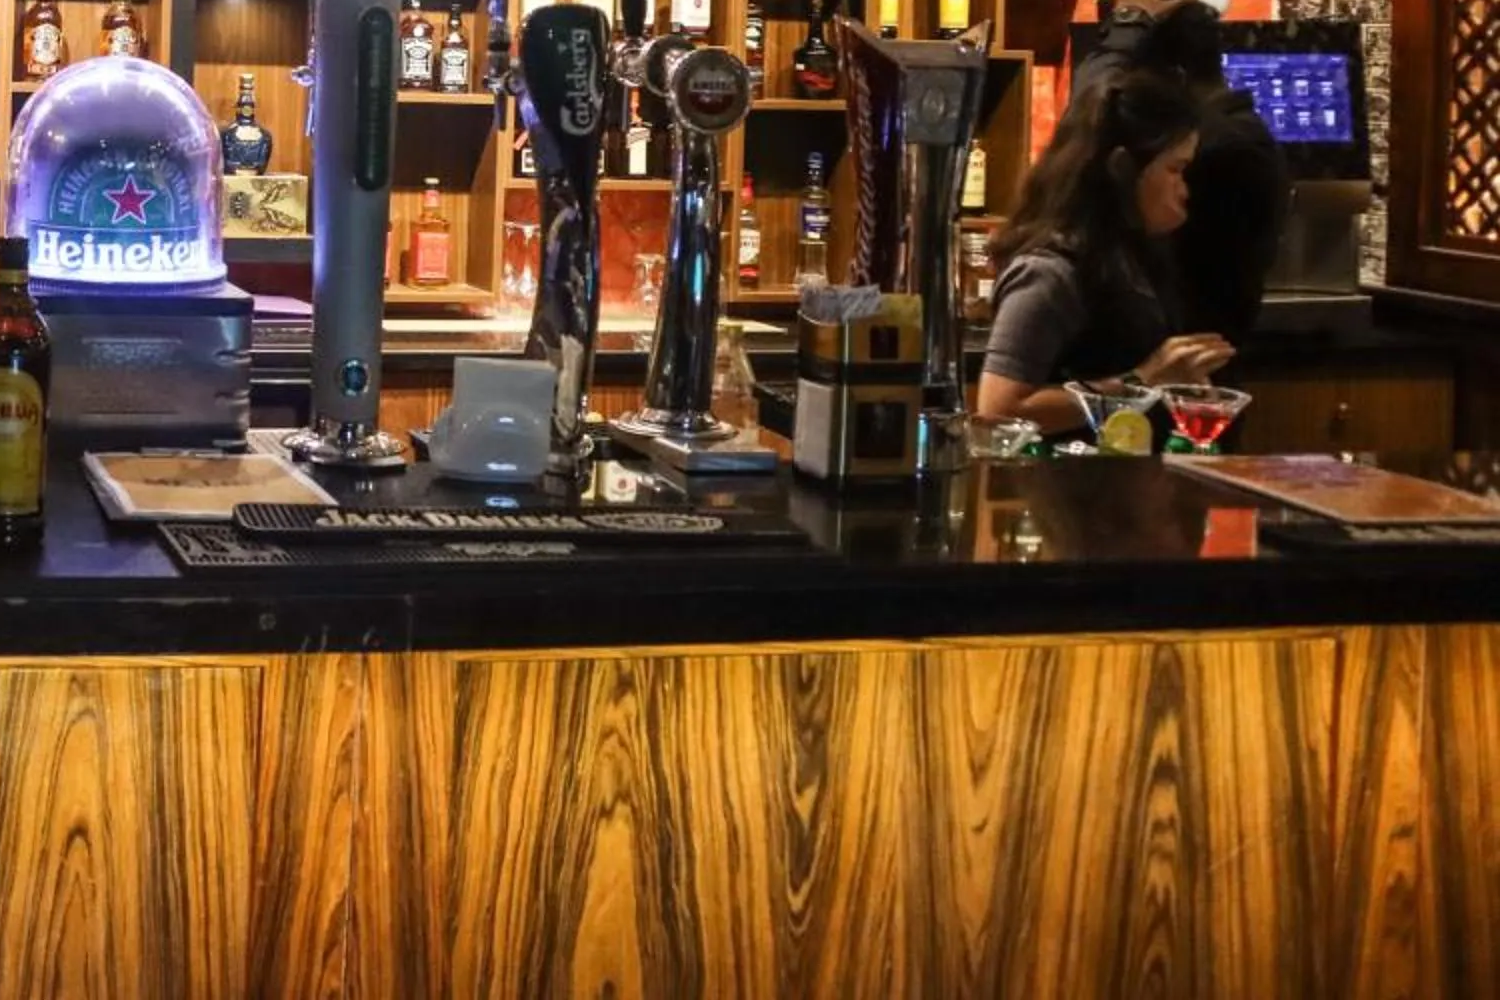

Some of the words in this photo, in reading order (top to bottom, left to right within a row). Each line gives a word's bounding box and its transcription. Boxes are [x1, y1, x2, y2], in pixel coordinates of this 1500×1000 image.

[560, 28, 598, 136] Carlsberg
[36, 229, 208, 271] Heineken
[315, 509, 429, 528] JACK
